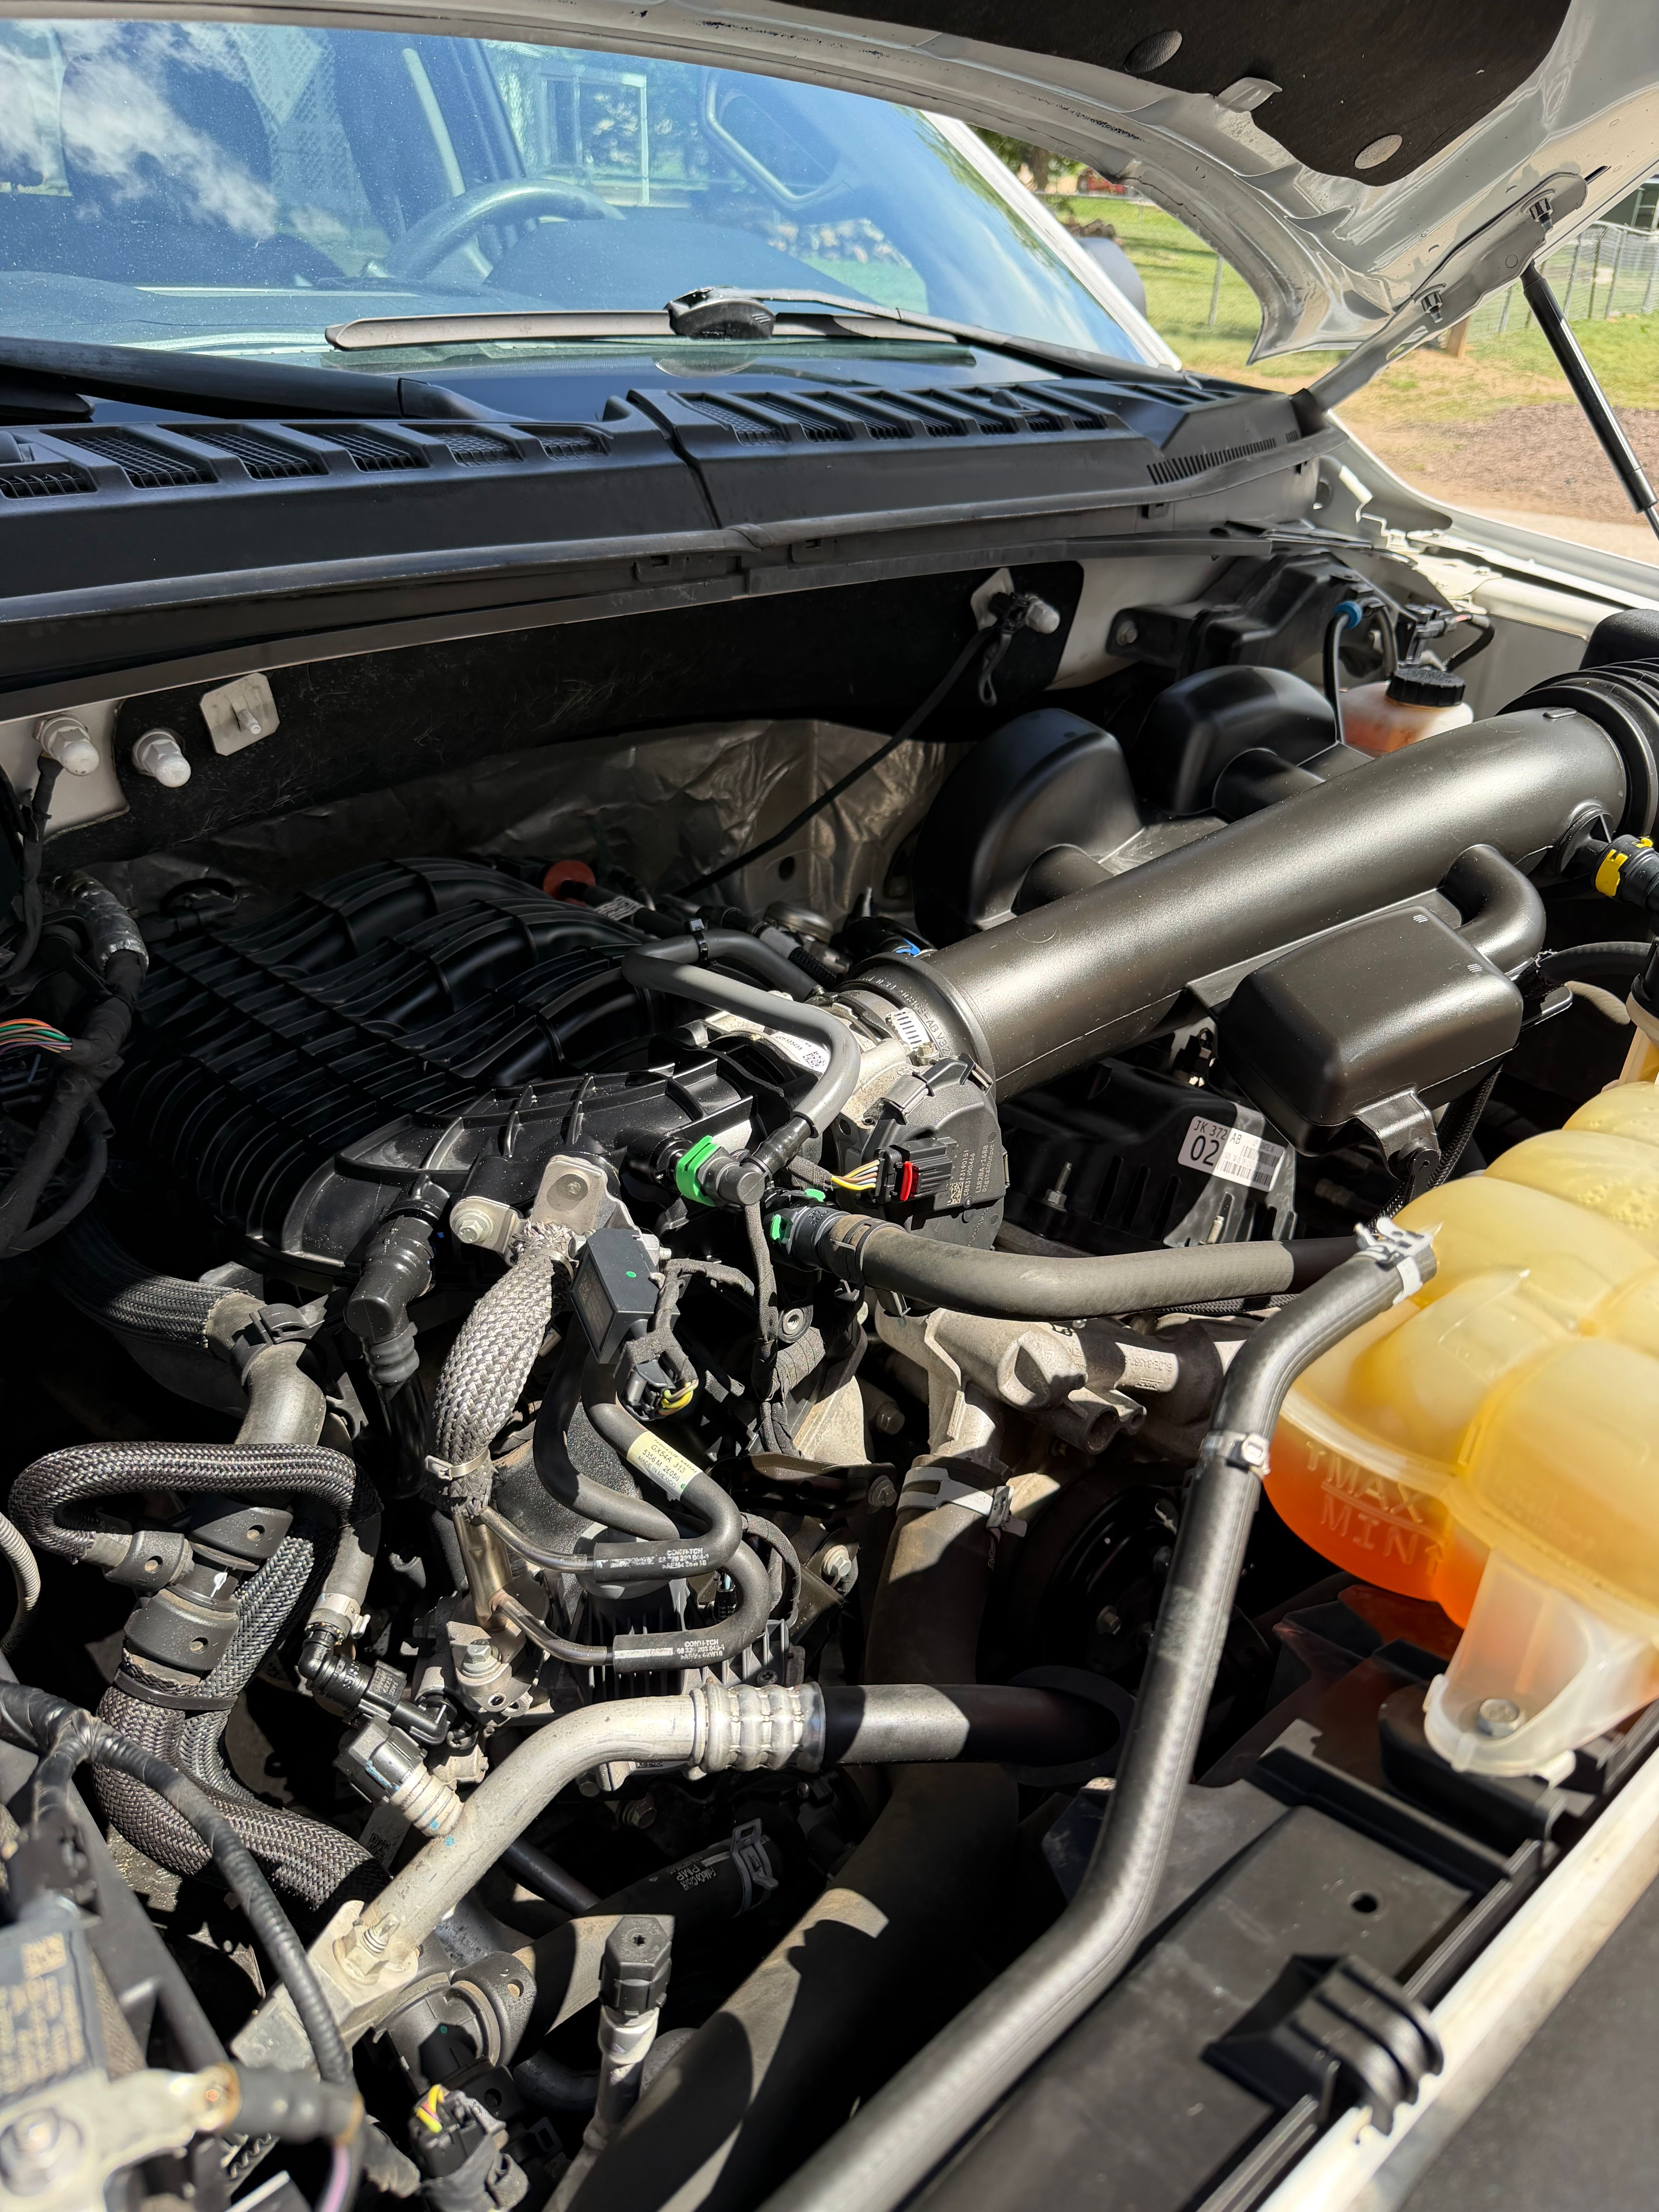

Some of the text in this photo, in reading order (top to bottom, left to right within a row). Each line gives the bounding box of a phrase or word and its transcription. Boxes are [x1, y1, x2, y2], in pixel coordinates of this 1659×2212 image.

[1194, 1120, 1242, 1144] JK 372 AB
[1190, 1135, 1219, 1166] 02
[981, 1143, 995, 1193] DigitalOutput
[638, 1455, 652, 1468] MADE
[658, 1472, 676, 1488] MEXICO
[651, 1444, 686, 1473] GX54A 313
[1326, 1455, 1423, 1523] MAX
[1321, 1494, 1420, 1565] MIN
[676, 1864, 701, 1881] PMP
